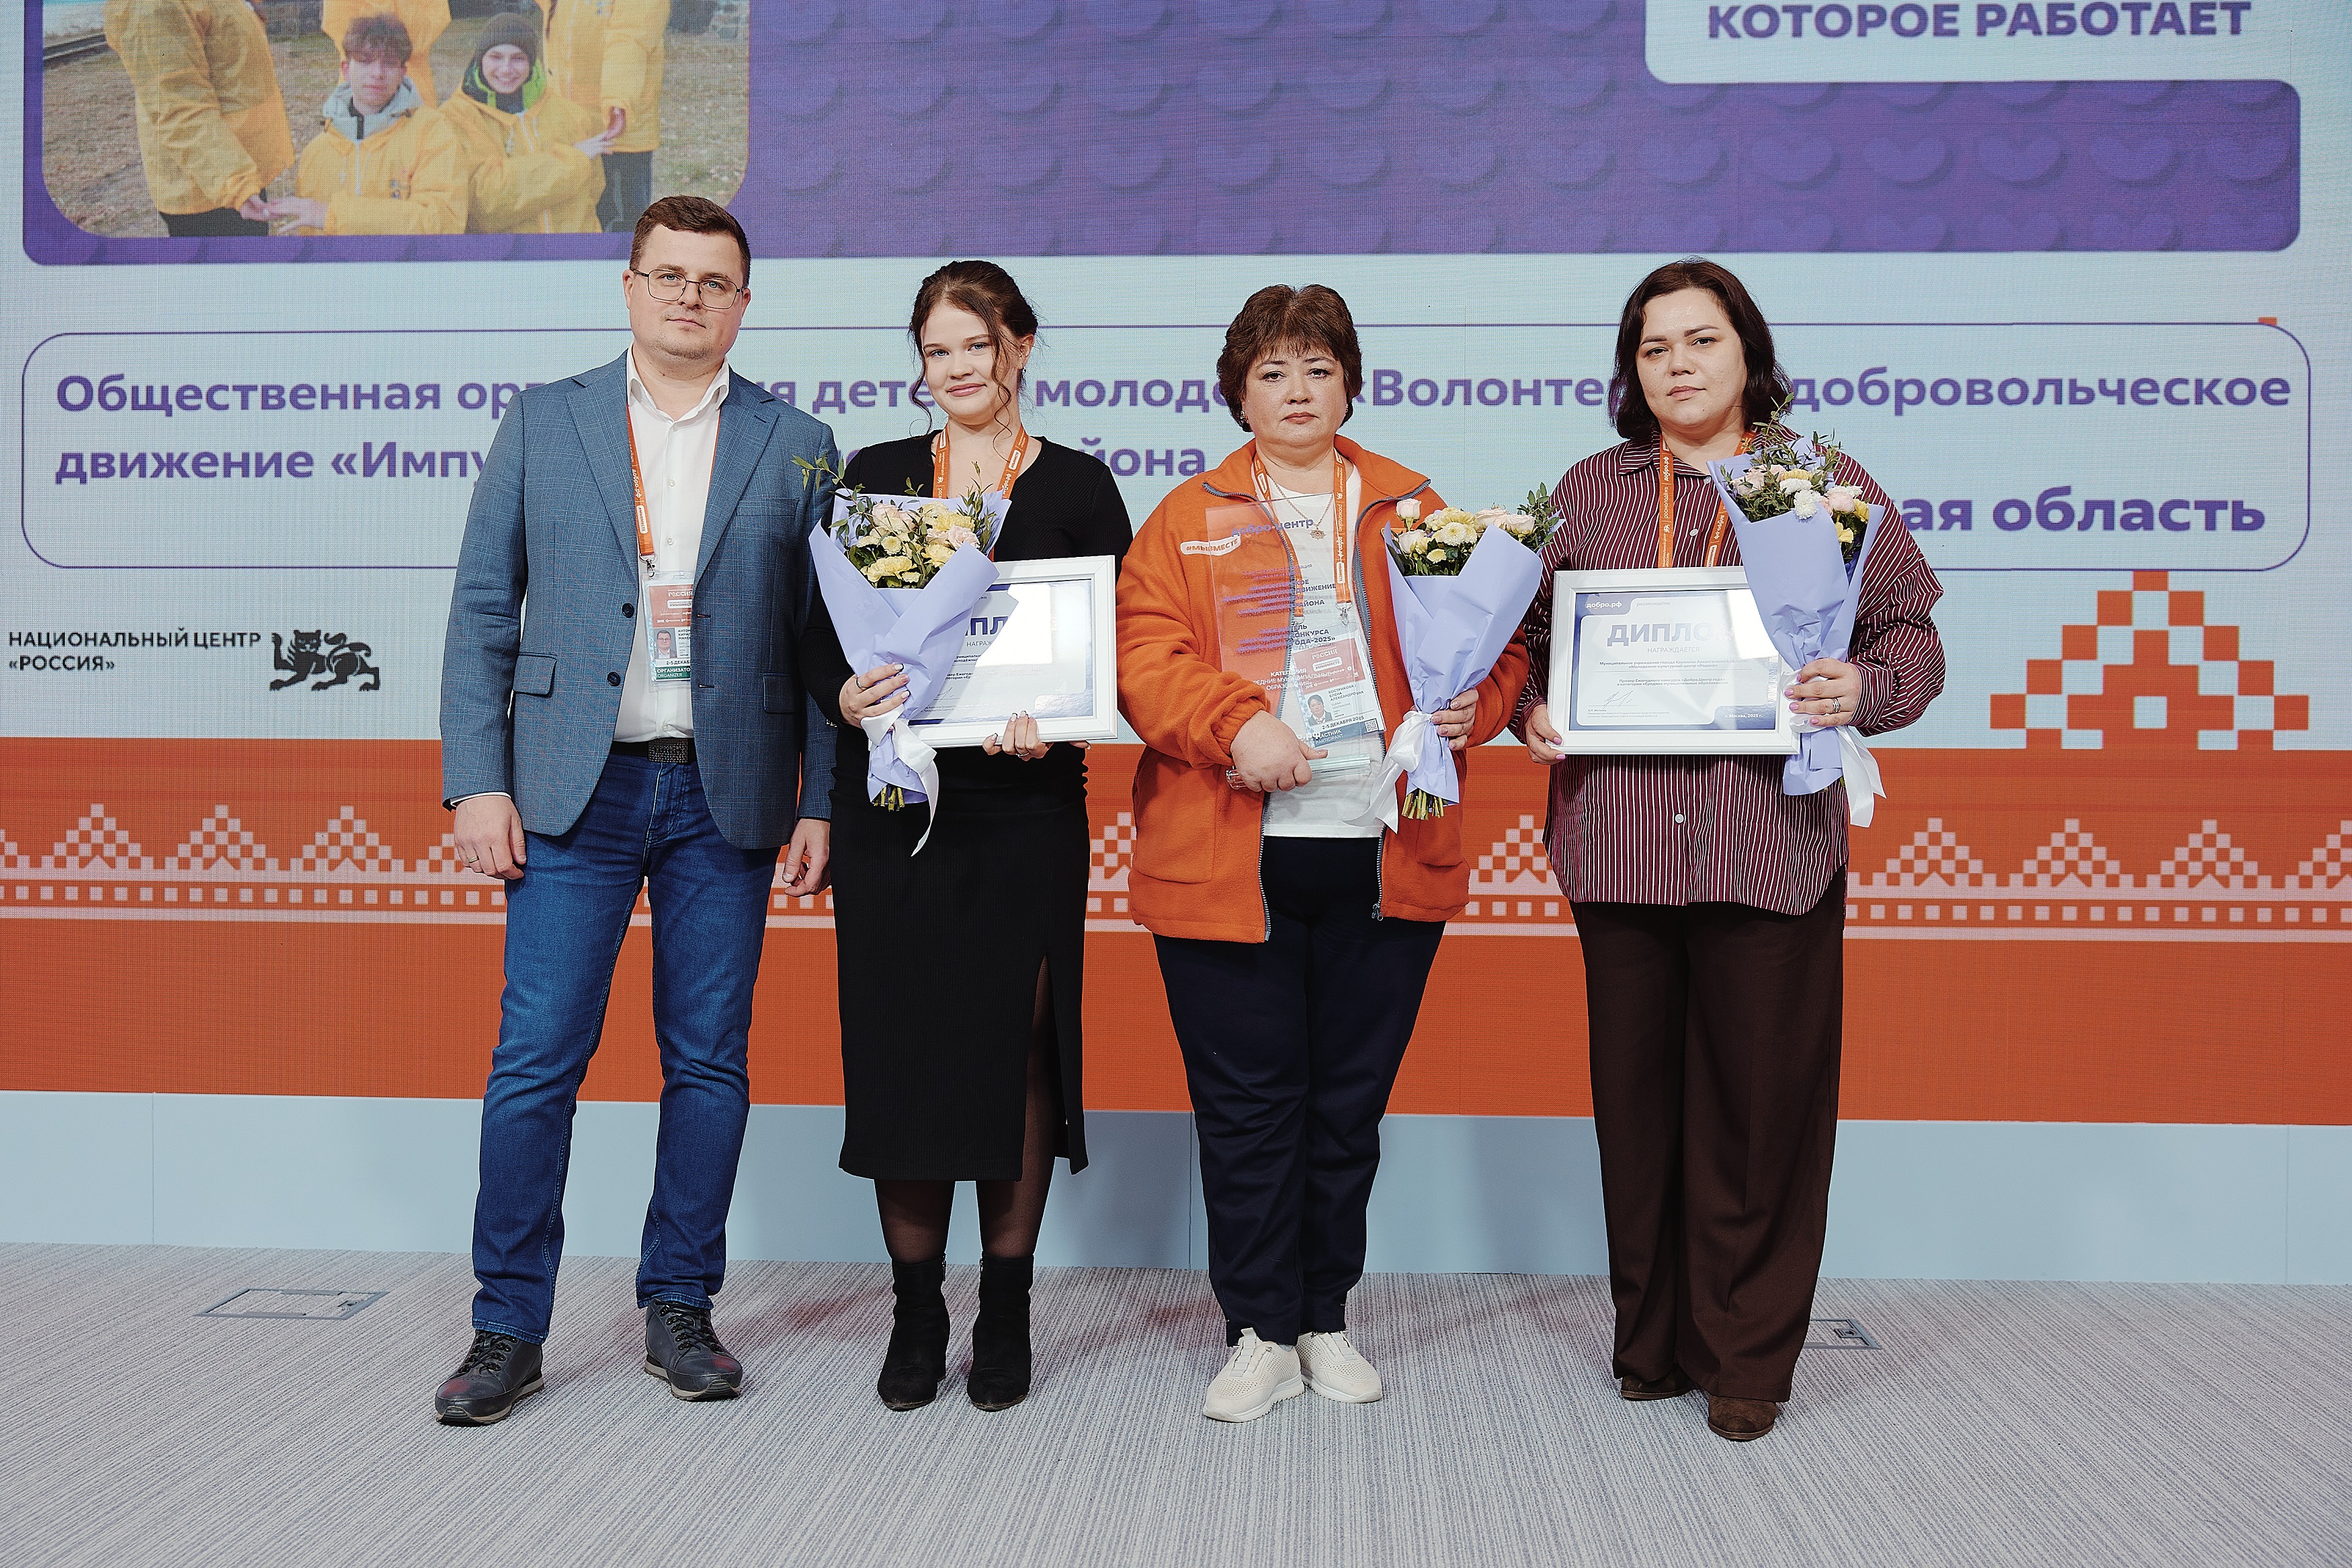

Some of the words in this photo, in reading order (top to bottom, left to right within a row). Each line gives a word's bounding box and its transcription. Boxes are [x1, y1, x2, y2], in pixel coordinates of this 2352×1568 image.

[1708, 3, 1960, 38] КОТОРОЕ
[1976, 1, 2251, 37] РАБОТАЕТ
[56, 374, 441, 417] Общественная
[55, 449, 313, 484] движение
[1992, 485, 2266, 531] область
[9, 627, 188, 649] НАЦИОНАЛЬНЫЙ
[194, 632, 261, 649] ЦЕНТР
[9, 655, 115, 671] «РОССИЯ»
